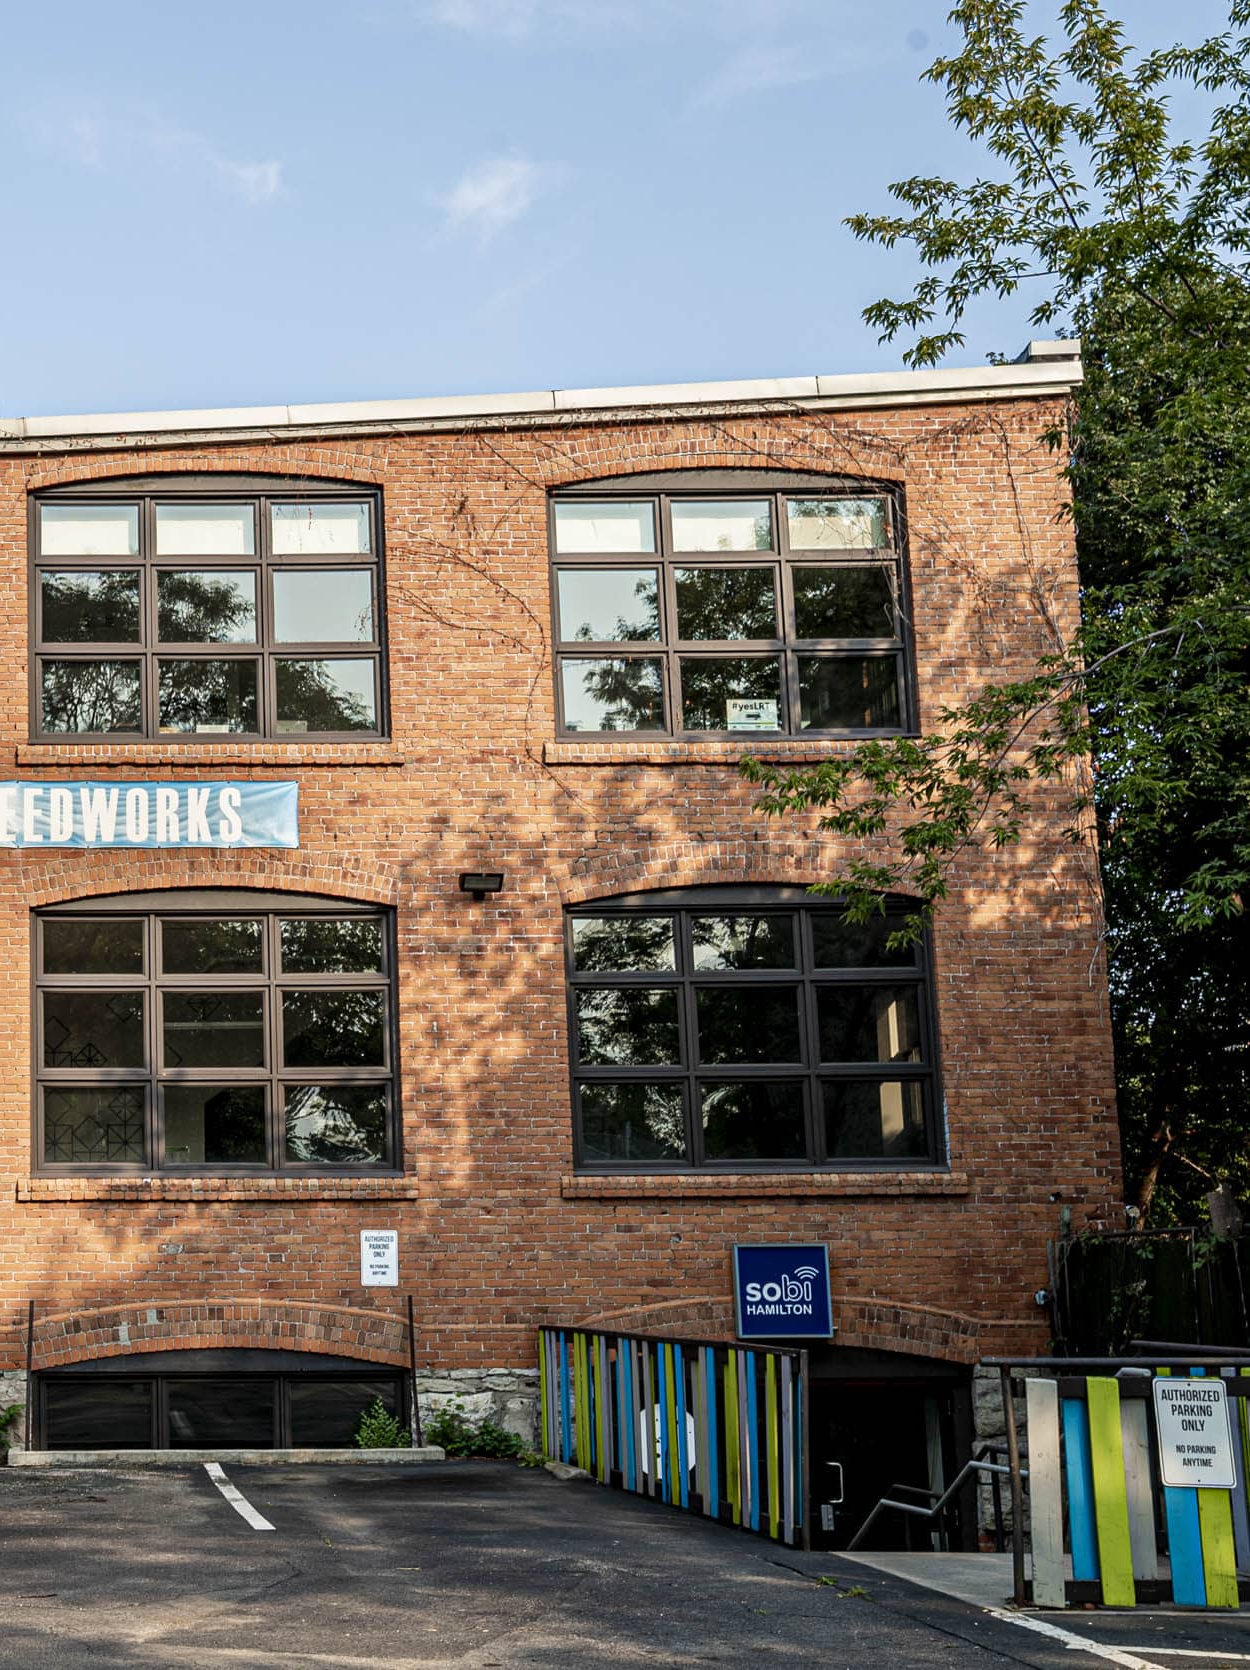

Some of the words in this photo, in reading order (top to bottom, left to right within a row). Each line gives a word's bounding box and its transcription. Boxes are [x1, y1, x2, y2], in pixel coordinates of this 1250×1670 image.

[745, 1274, 812, 1302] sobi
[746, 1304, 812, 1315] HAMILTON
[1161, 1389, 1220, 1402] AUTHORIZED
[1171, 1404, 1213, 1417] PARKING
[1181, 1419, 1205, 1432] ONLY
[1176, 1445, 1185, 1454] NO
[1187, 1445, 1216, 1454] PARKING
[1182, 1458, 1213, 1468] ANYTIME
